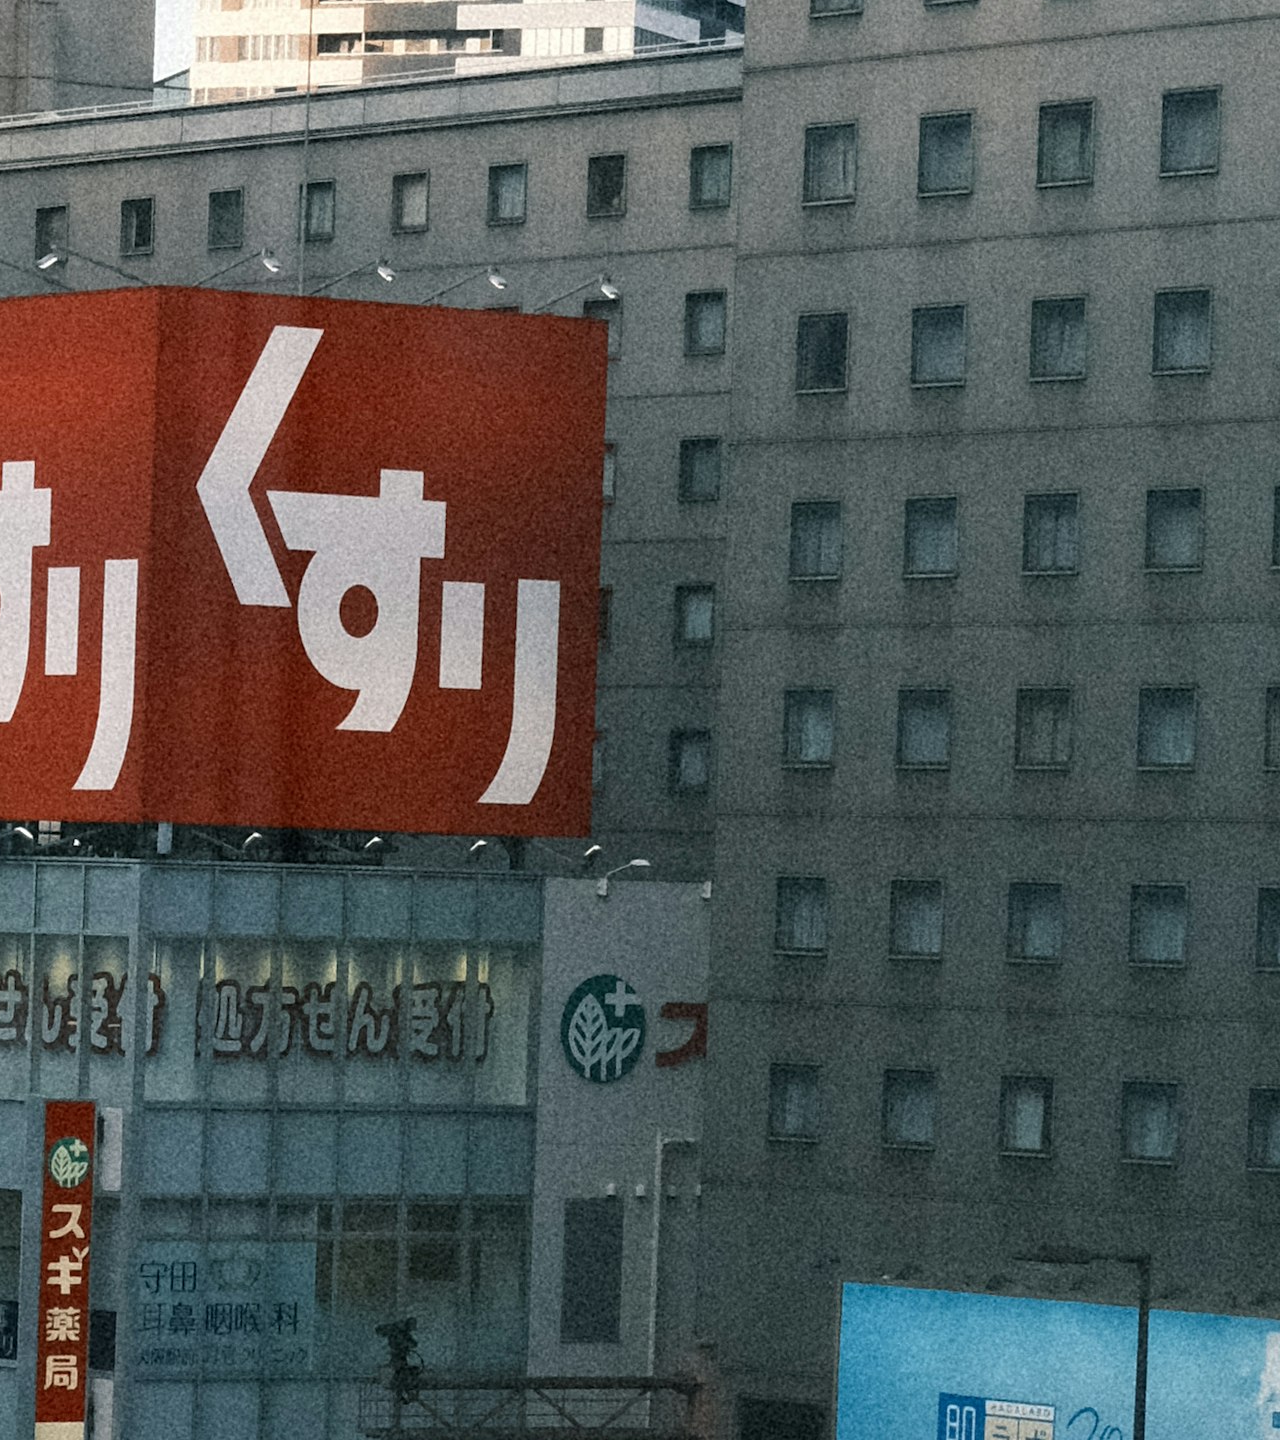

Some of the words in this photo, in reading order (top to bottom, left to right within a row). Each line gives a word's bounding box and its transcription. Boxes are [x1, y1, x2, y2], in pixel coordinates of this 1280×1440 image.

[195, 324, 561, 805] くすり
[44, 1203, 90, 1393] スギ薬局
